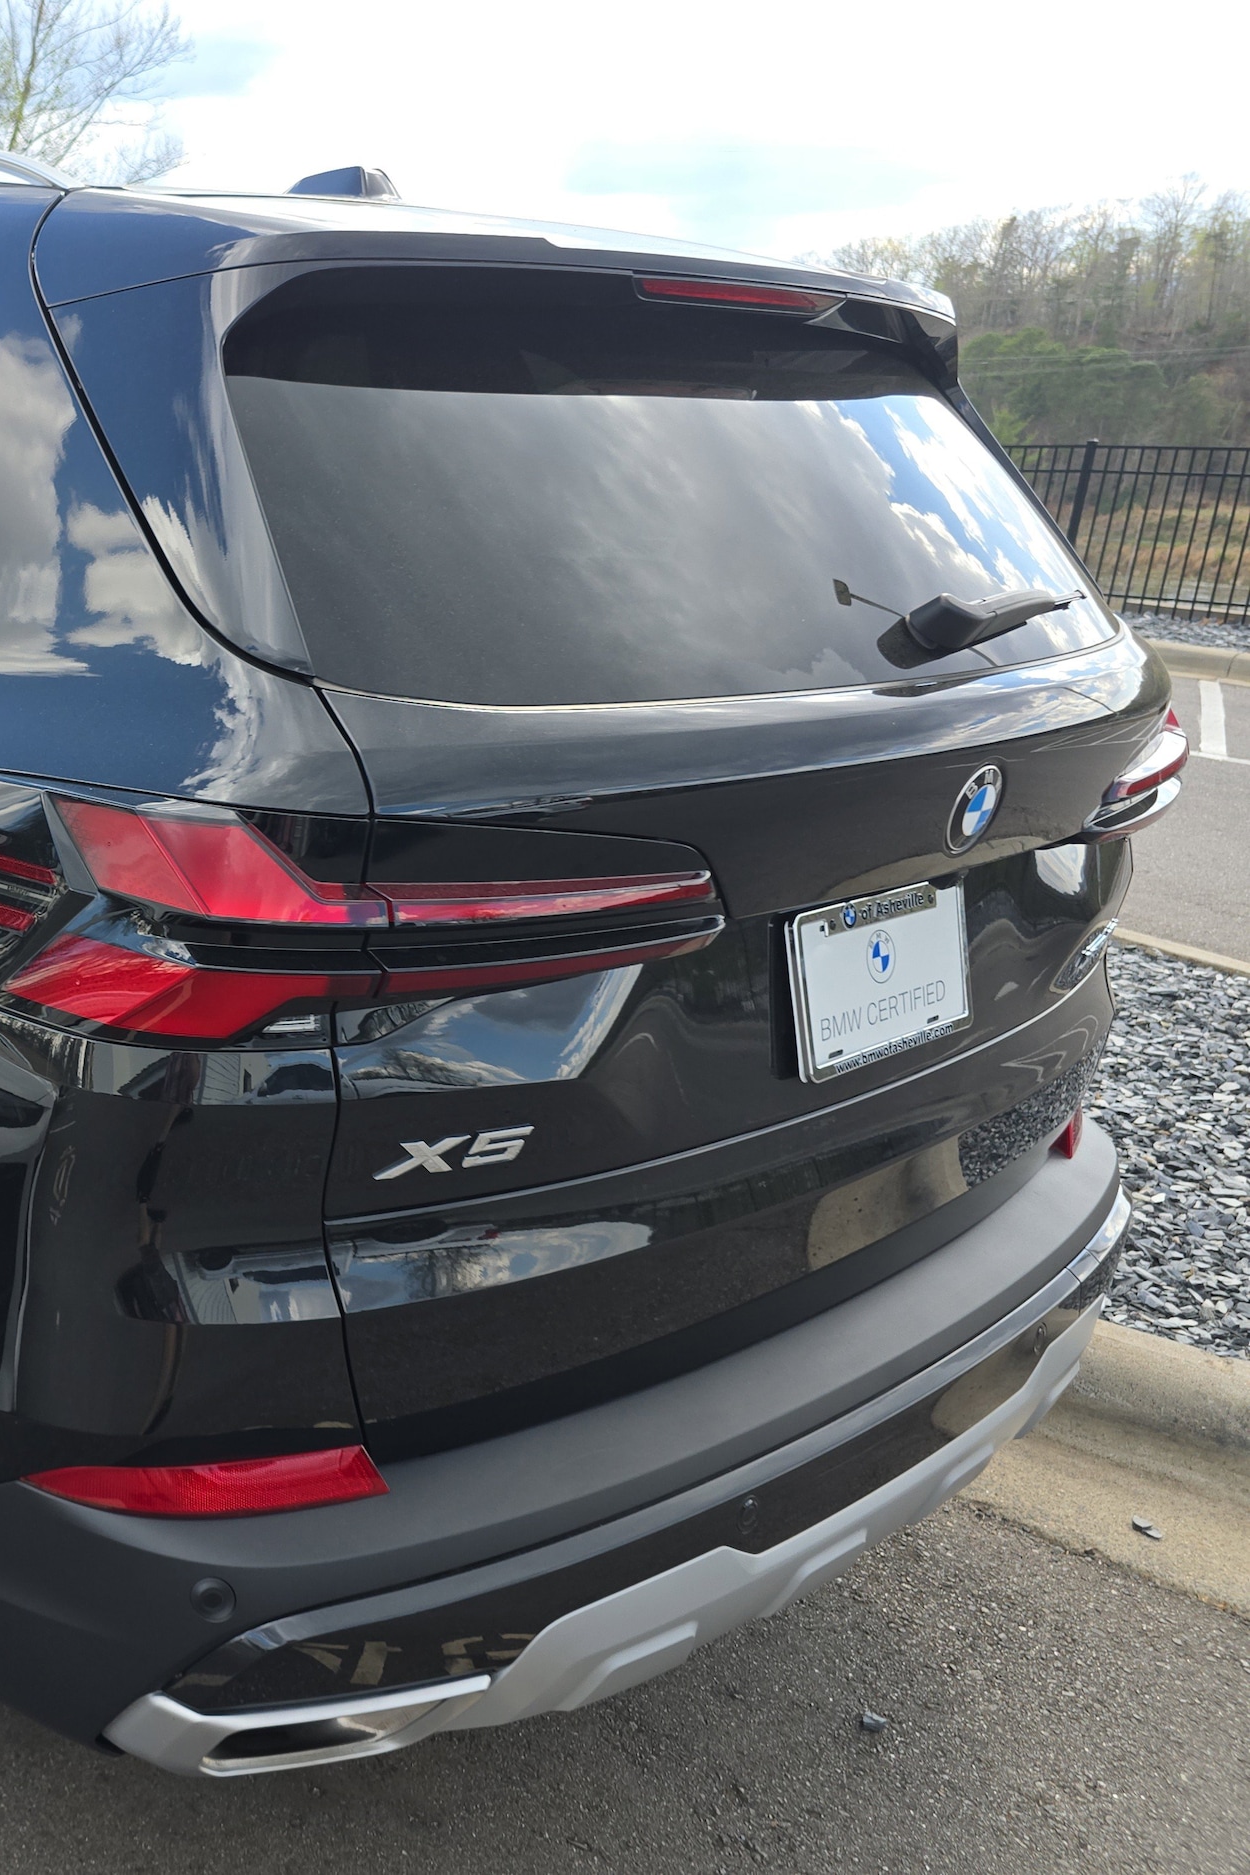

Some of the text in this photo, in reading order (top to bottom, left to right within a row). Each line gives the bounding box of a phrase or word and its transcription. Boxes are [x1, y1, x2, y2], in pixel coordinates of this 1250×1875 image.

[860, 902, 872, 920] of
[875, 891, 925, 917] Asheville
[820, 979, 947, 1042] BMW CERTIFIED
[834, 1022, 954, 1074] www.bmwofasheville.com
[372, 1123, 535, 1181] X5
